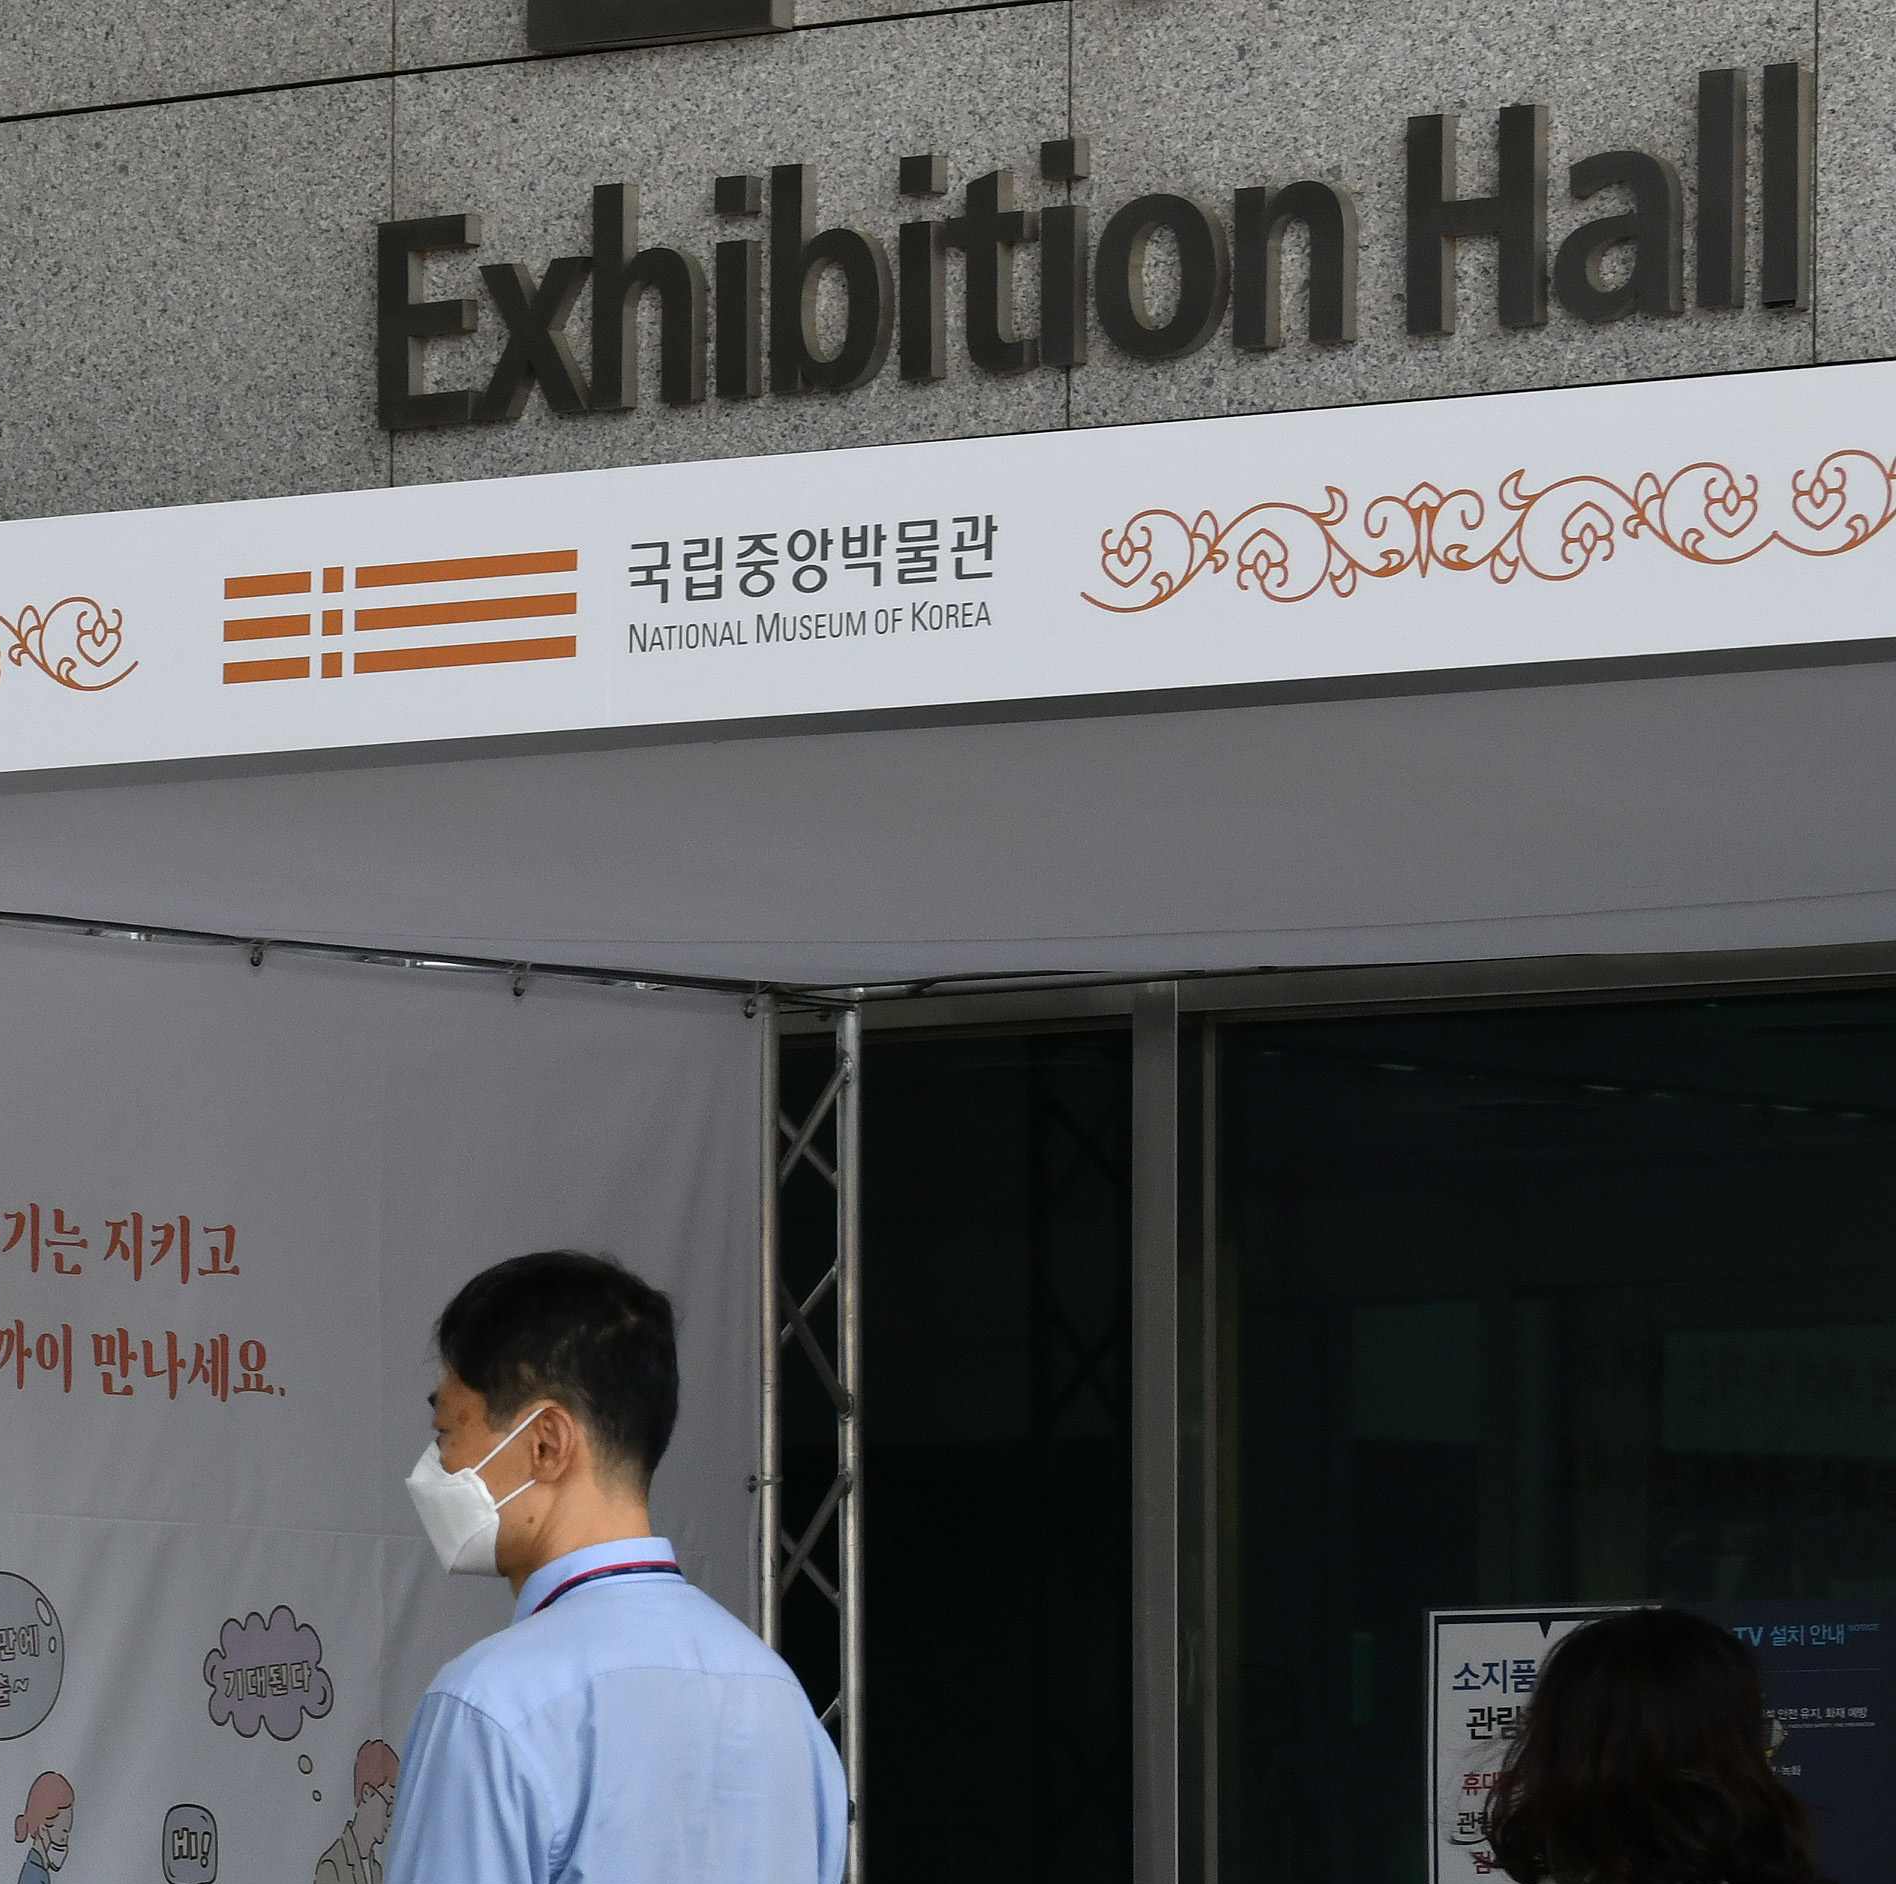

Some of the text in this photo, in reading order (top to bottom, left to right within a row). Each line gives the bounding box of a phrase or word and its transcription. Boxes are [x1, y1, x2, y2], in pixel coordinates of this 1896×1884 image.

[376, 60, 1816, 431] Exhibition Hall
[627, 514, 999, 604] 국립중앙박물관
[628, 599, 993, 654] NATIONAL MUSEUM OF KOREA
[103, 1211, 241, 1285] 지키고
[90, 1326, 287, 1402] 만나세요.
[1770, 1624, 1805, 1647] 설치
[1809, 1623, 1846, 1646] 안내
[223, 1660, 313, 1702] 기대된다
[1452, 1659, 1538, 1694] 소지품
